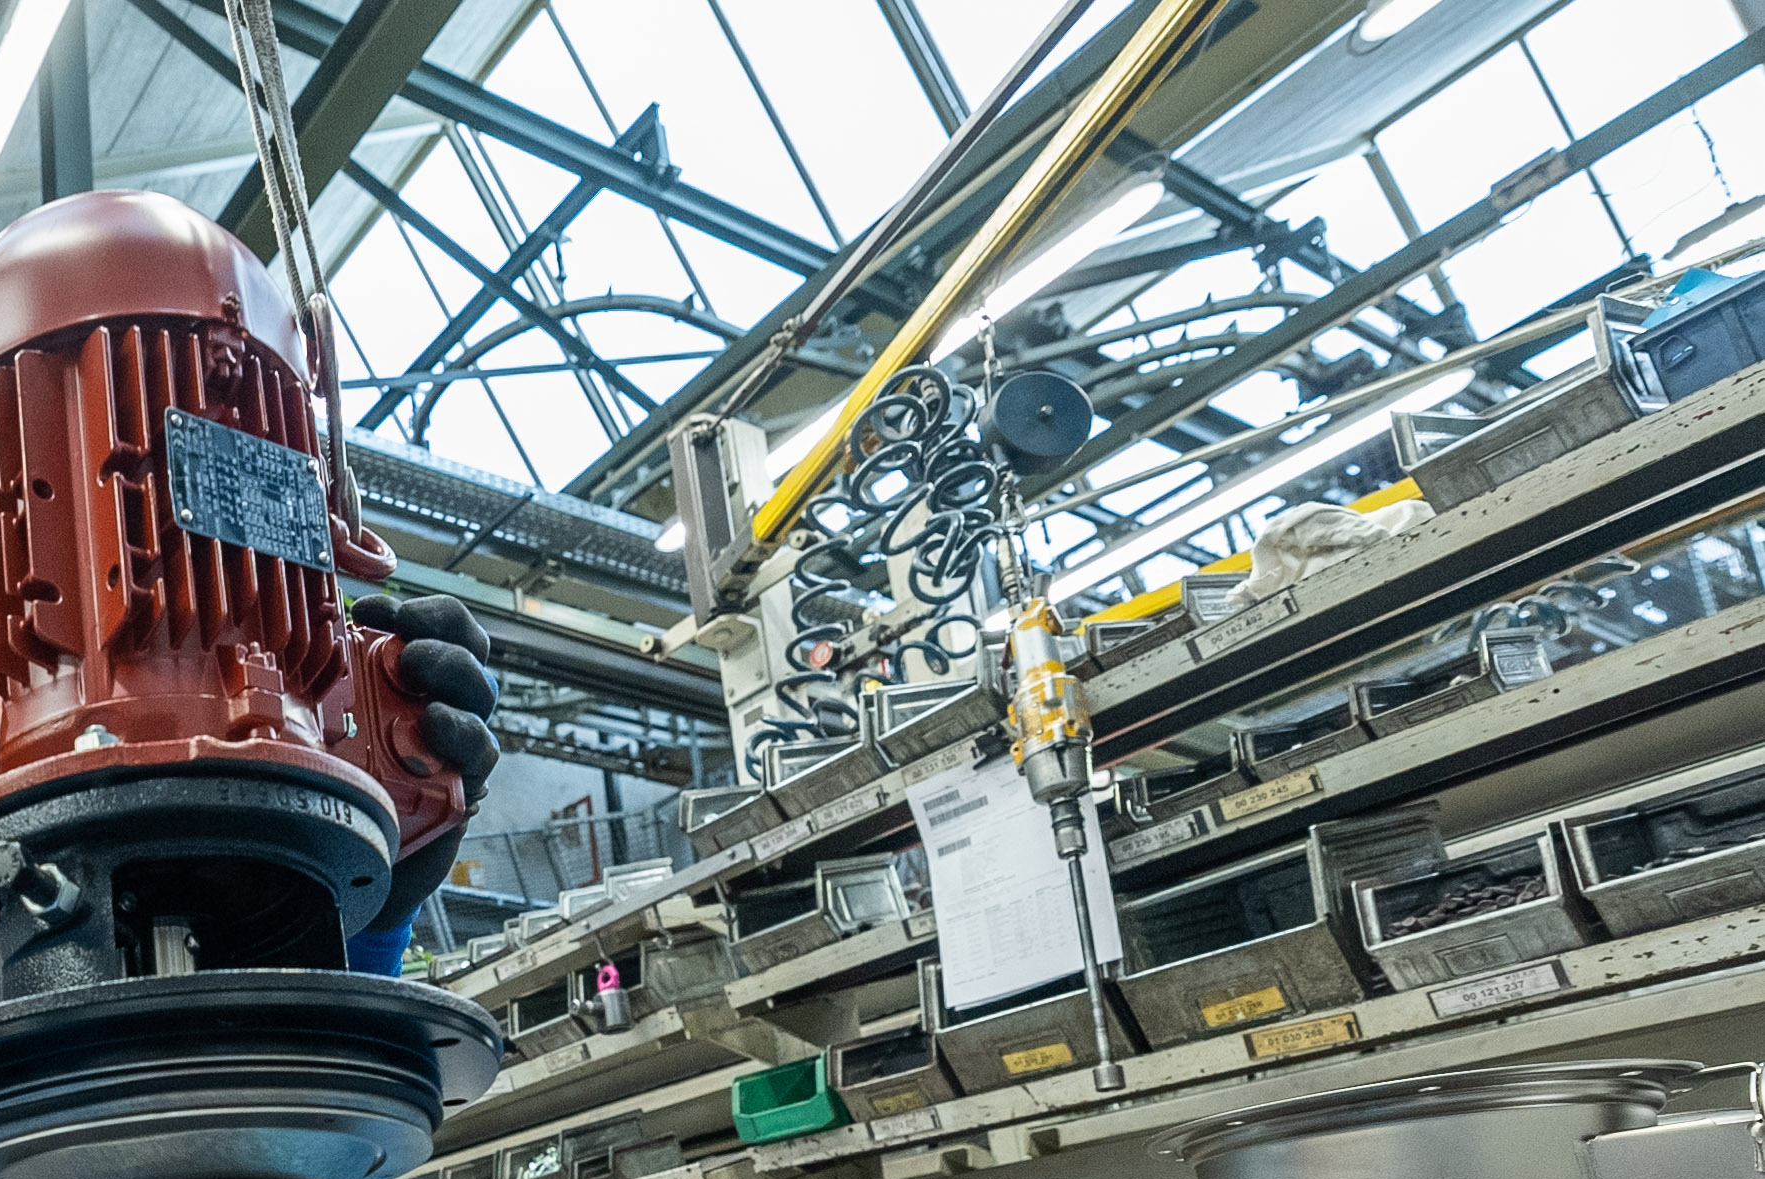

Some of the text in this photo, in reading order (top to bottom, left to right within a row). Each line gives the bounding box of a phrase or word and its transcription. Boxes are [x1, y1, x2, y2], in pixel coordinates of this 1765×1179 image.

[1463, 991, 1476, 1001] 00
[1481, 987, 1500, 998] 121
[1505, 981, 1524, 992] 237
